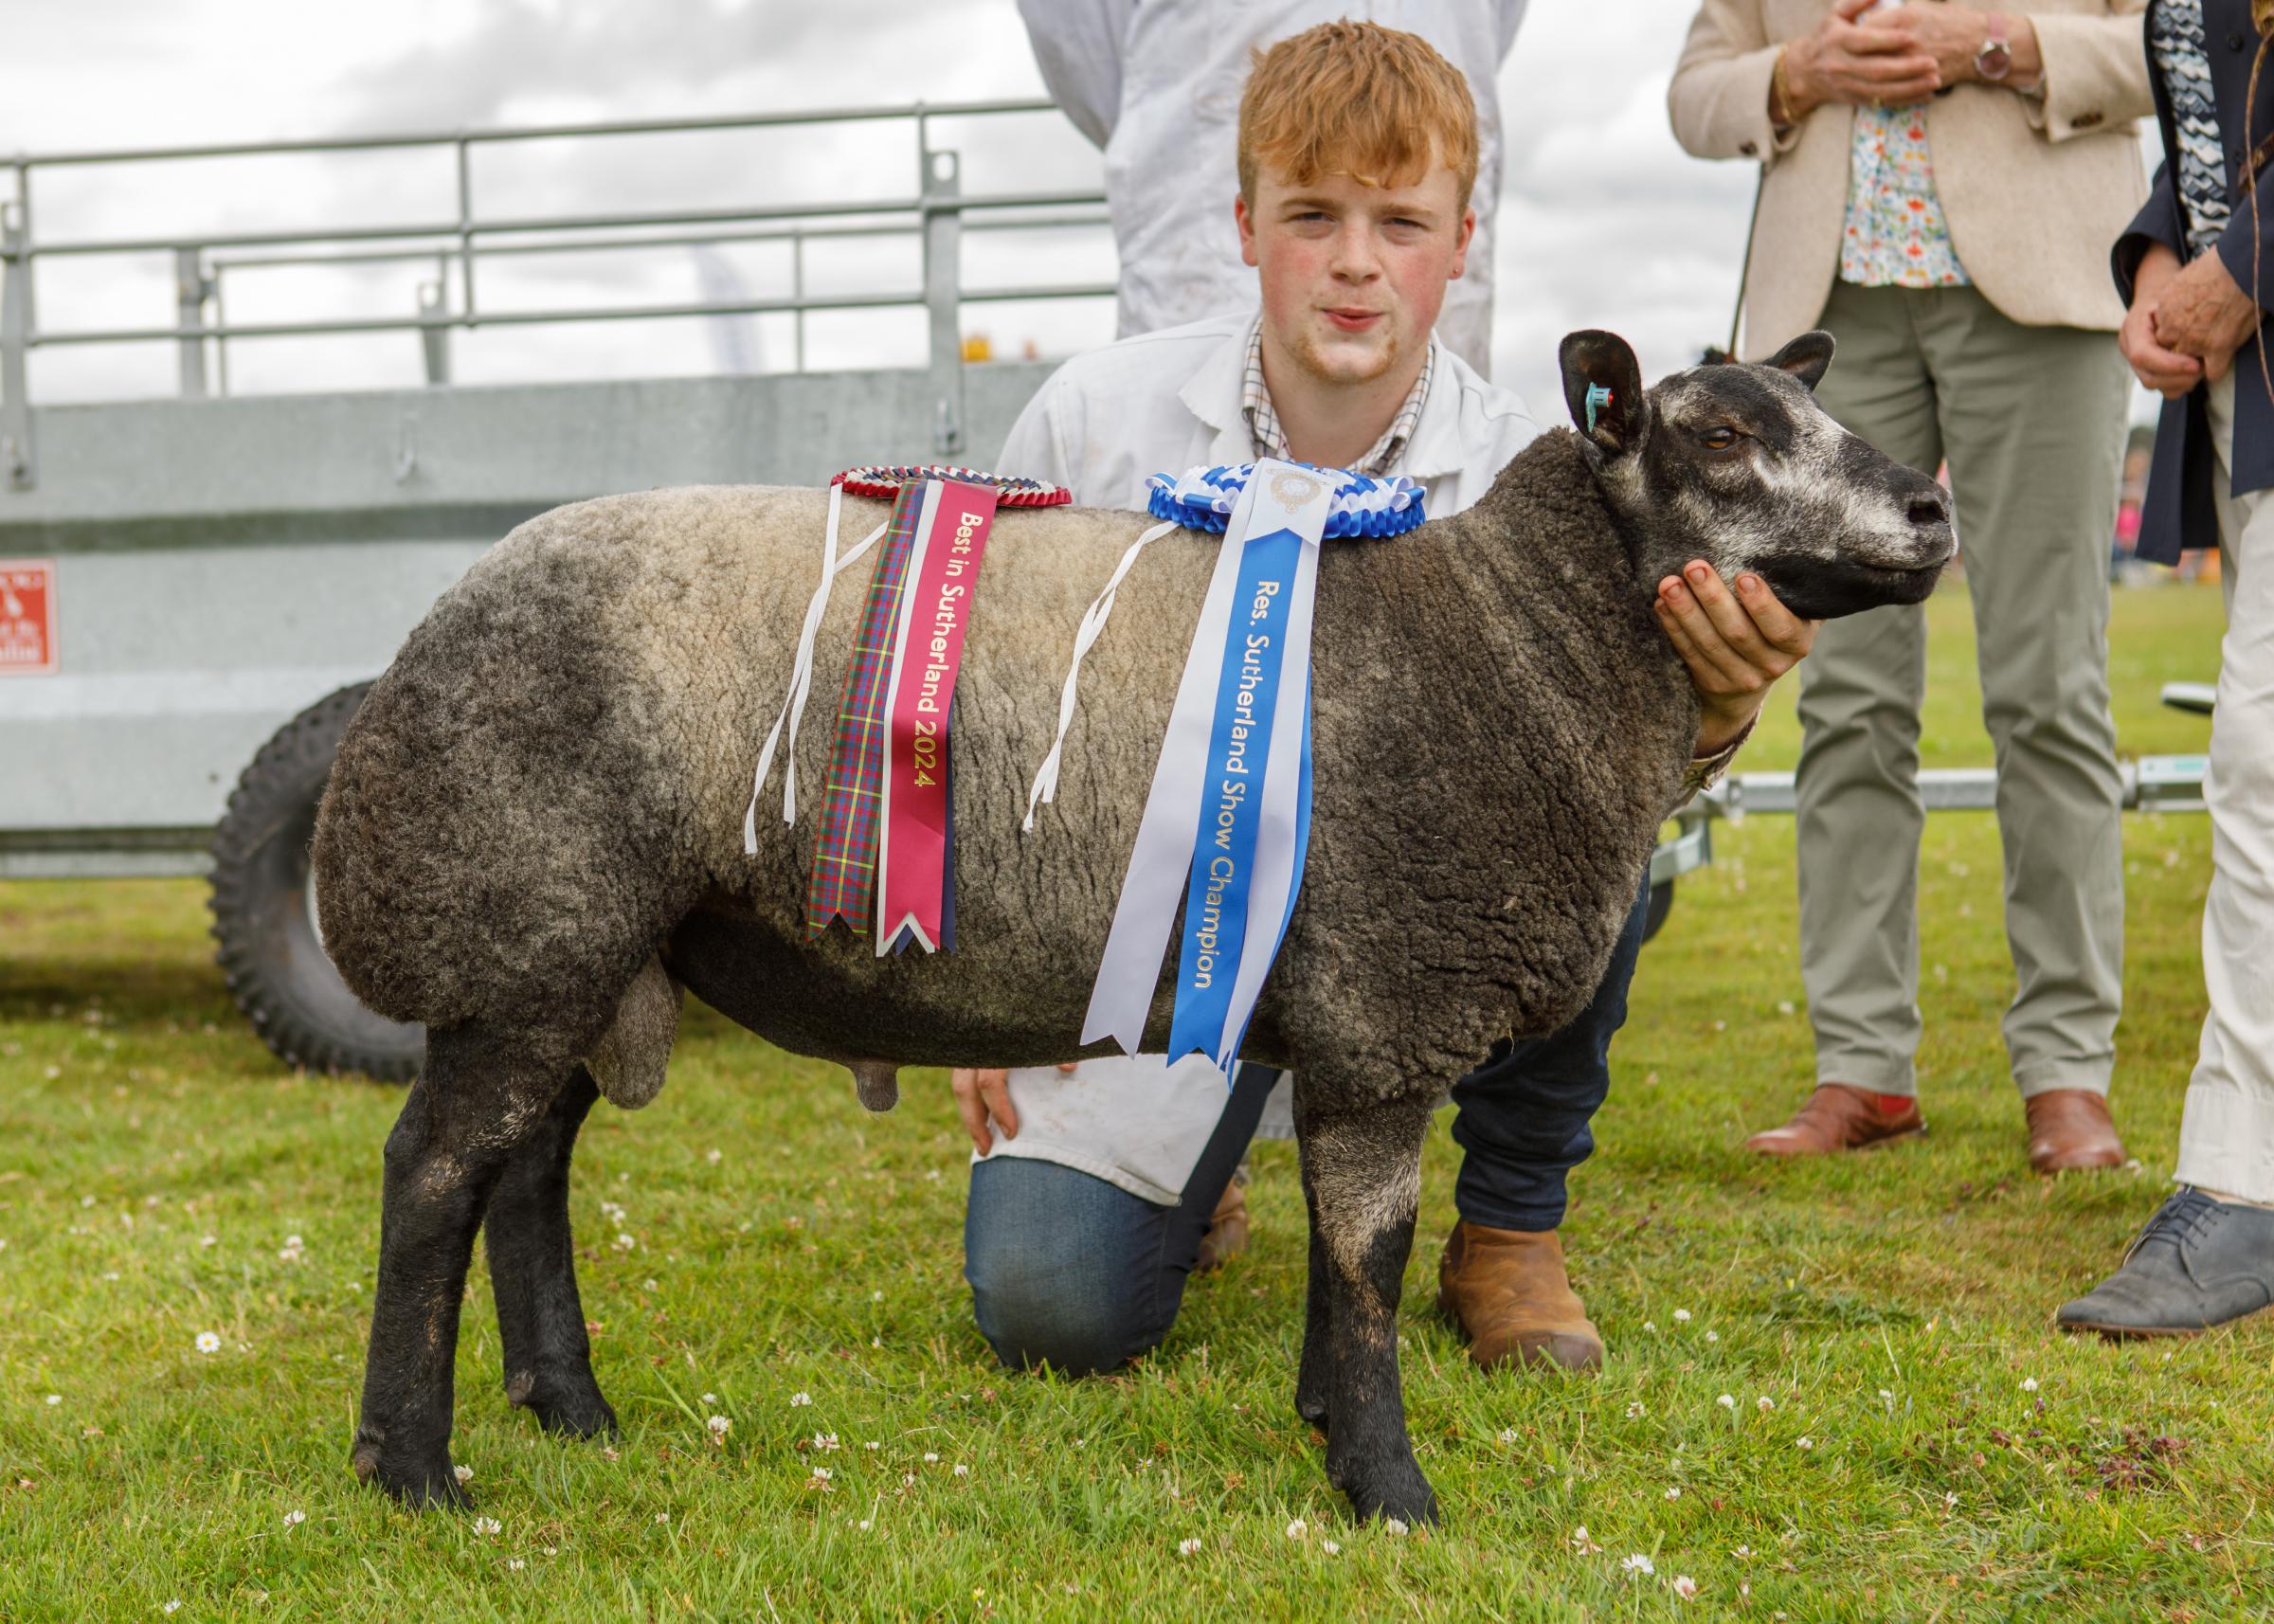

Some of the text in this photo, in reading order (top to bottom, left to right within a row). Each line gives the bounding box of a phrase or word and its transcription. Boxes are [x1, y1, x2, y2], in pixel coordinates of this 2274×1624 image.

[913, 512, 984, 787] Best in Sutherland 2024
[1194, 581, 1279, 989] Res. Sutherland Show Champion
